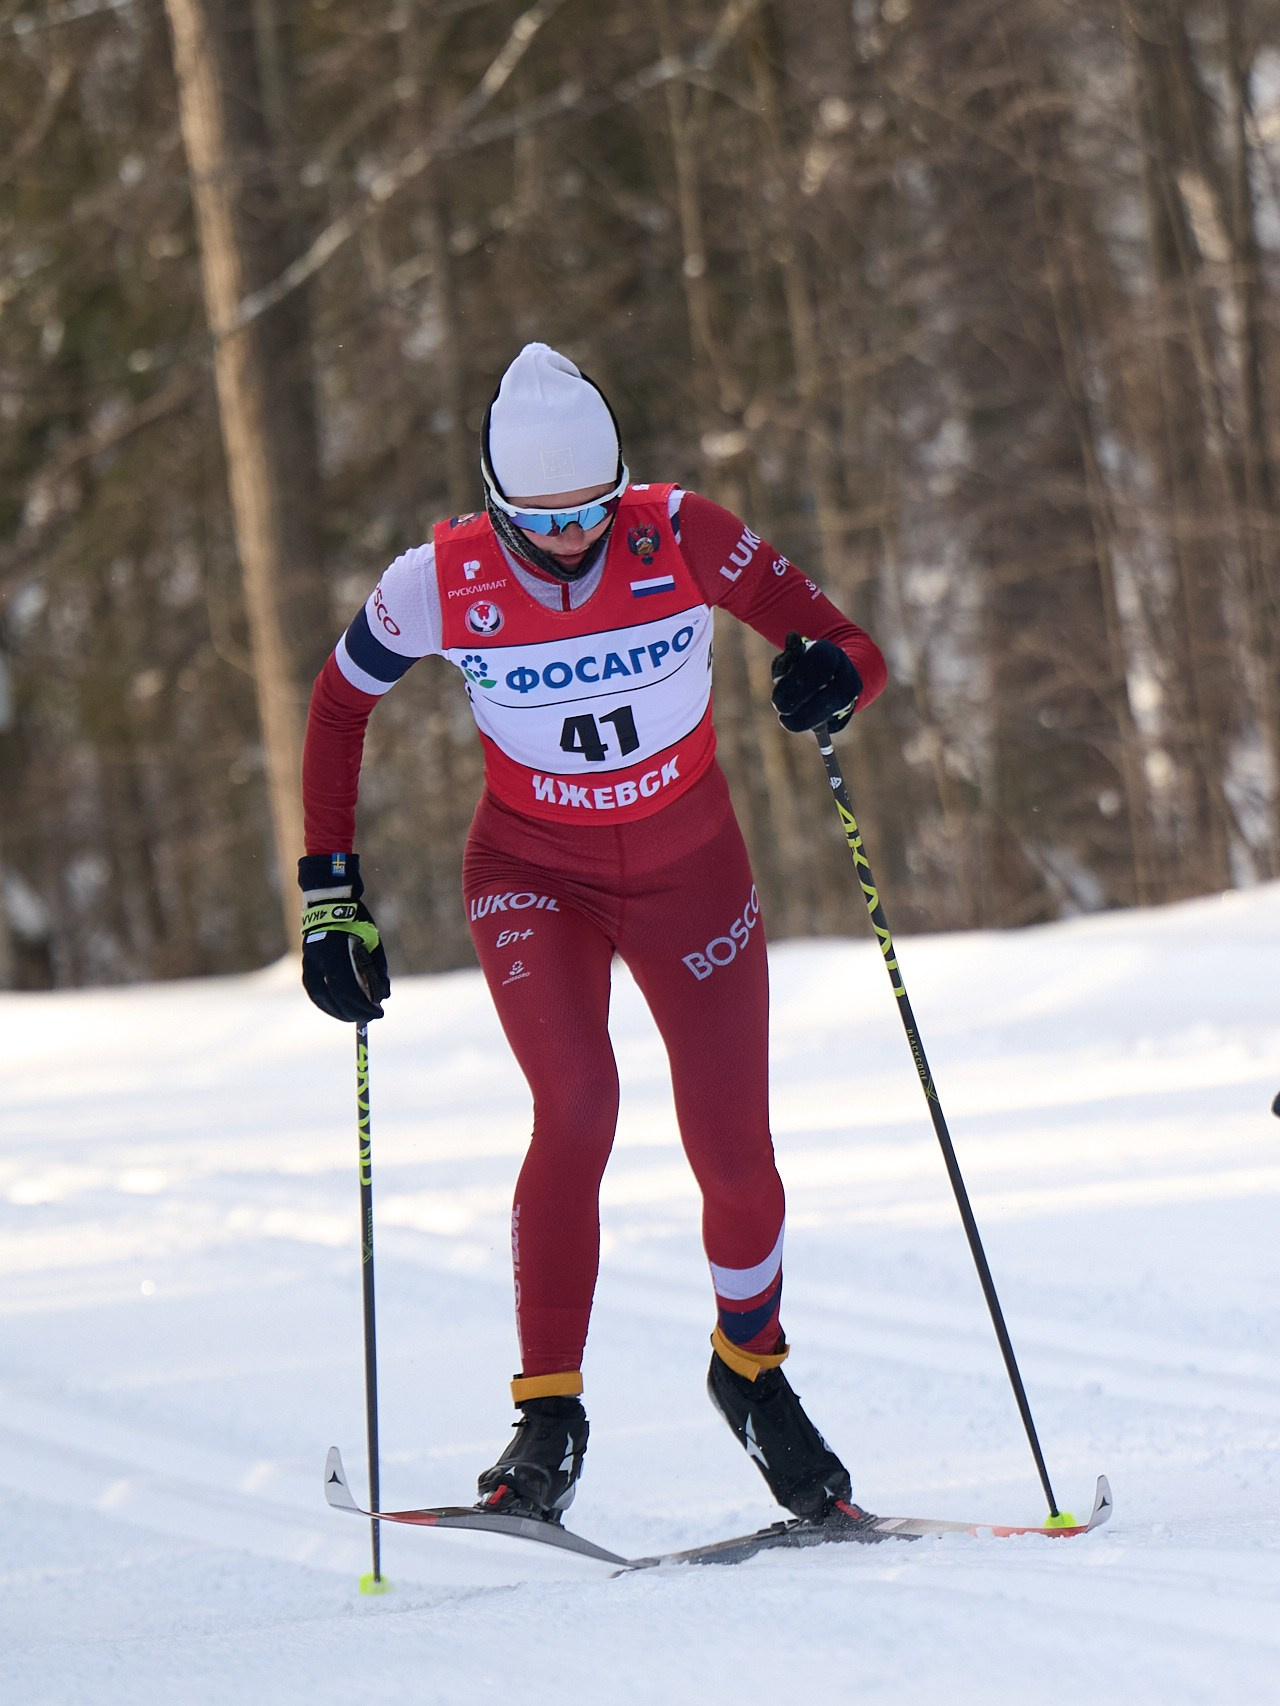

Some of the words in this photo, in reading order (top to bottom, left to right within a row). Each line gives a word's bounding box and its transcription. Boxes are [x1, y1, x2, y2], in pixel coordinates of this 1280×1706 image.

[719, 524, 761, 582] LUK
[373, 588, 401, 636] SCO
[448, 579, 507, 599] РУСКЛИМАТ
[505, 626, 694, 694] ФОСАГРО
[559, 704, 640, 762] 41
[532, 754, 681, 810] ИЖЕВСК
[471, 892, 560, 921] LUKOIL
[496, 928, 534, 948] En+
